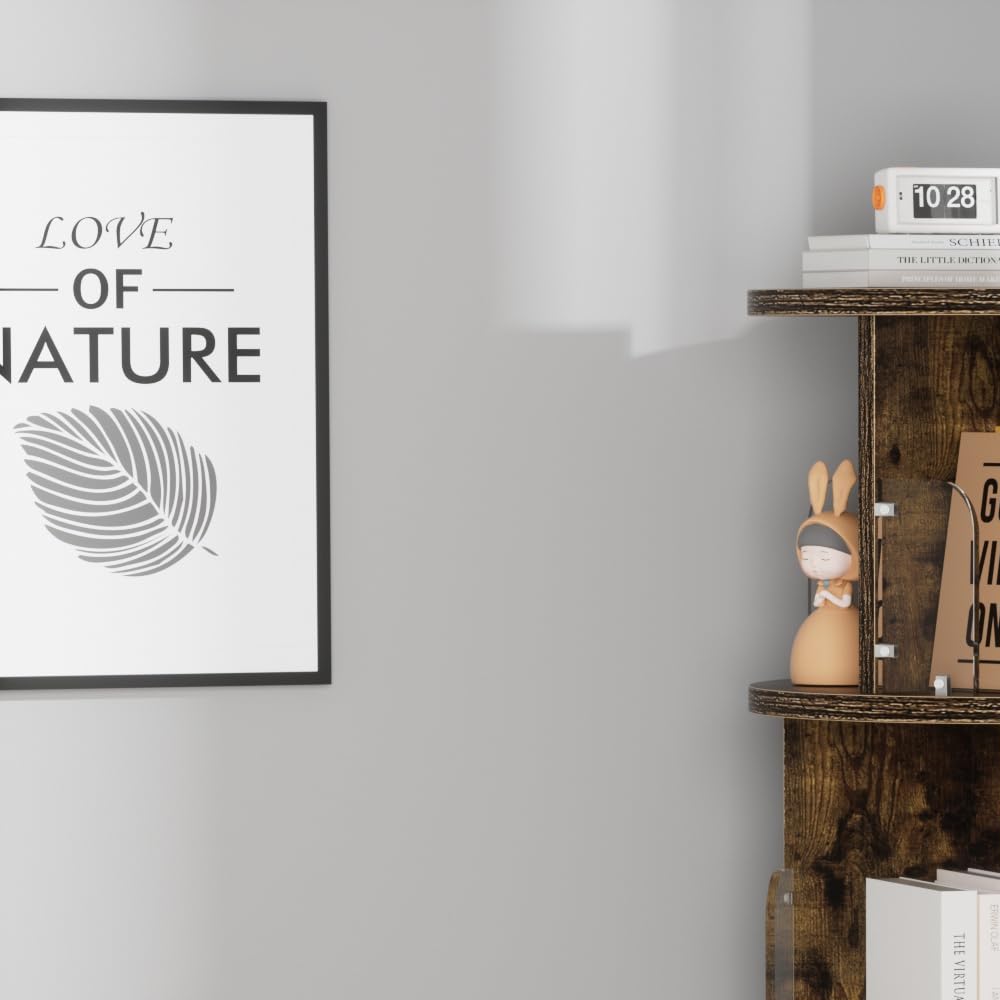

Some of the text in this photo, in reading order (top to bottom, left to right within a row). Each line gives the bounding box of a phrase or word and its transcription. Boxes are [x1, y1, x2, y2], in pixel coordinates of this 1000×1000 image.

[914, 185, 976, 209] 10 28
[35, 211, 174, 250] LOVE
[896, 256, 918, 265] THE
[919, 256, 956, 265] LITTLE
[71, 267, 143, 310] OF
[990, 904, 1000, 931] ERWIN
[953, 933, 966, 955] THE
